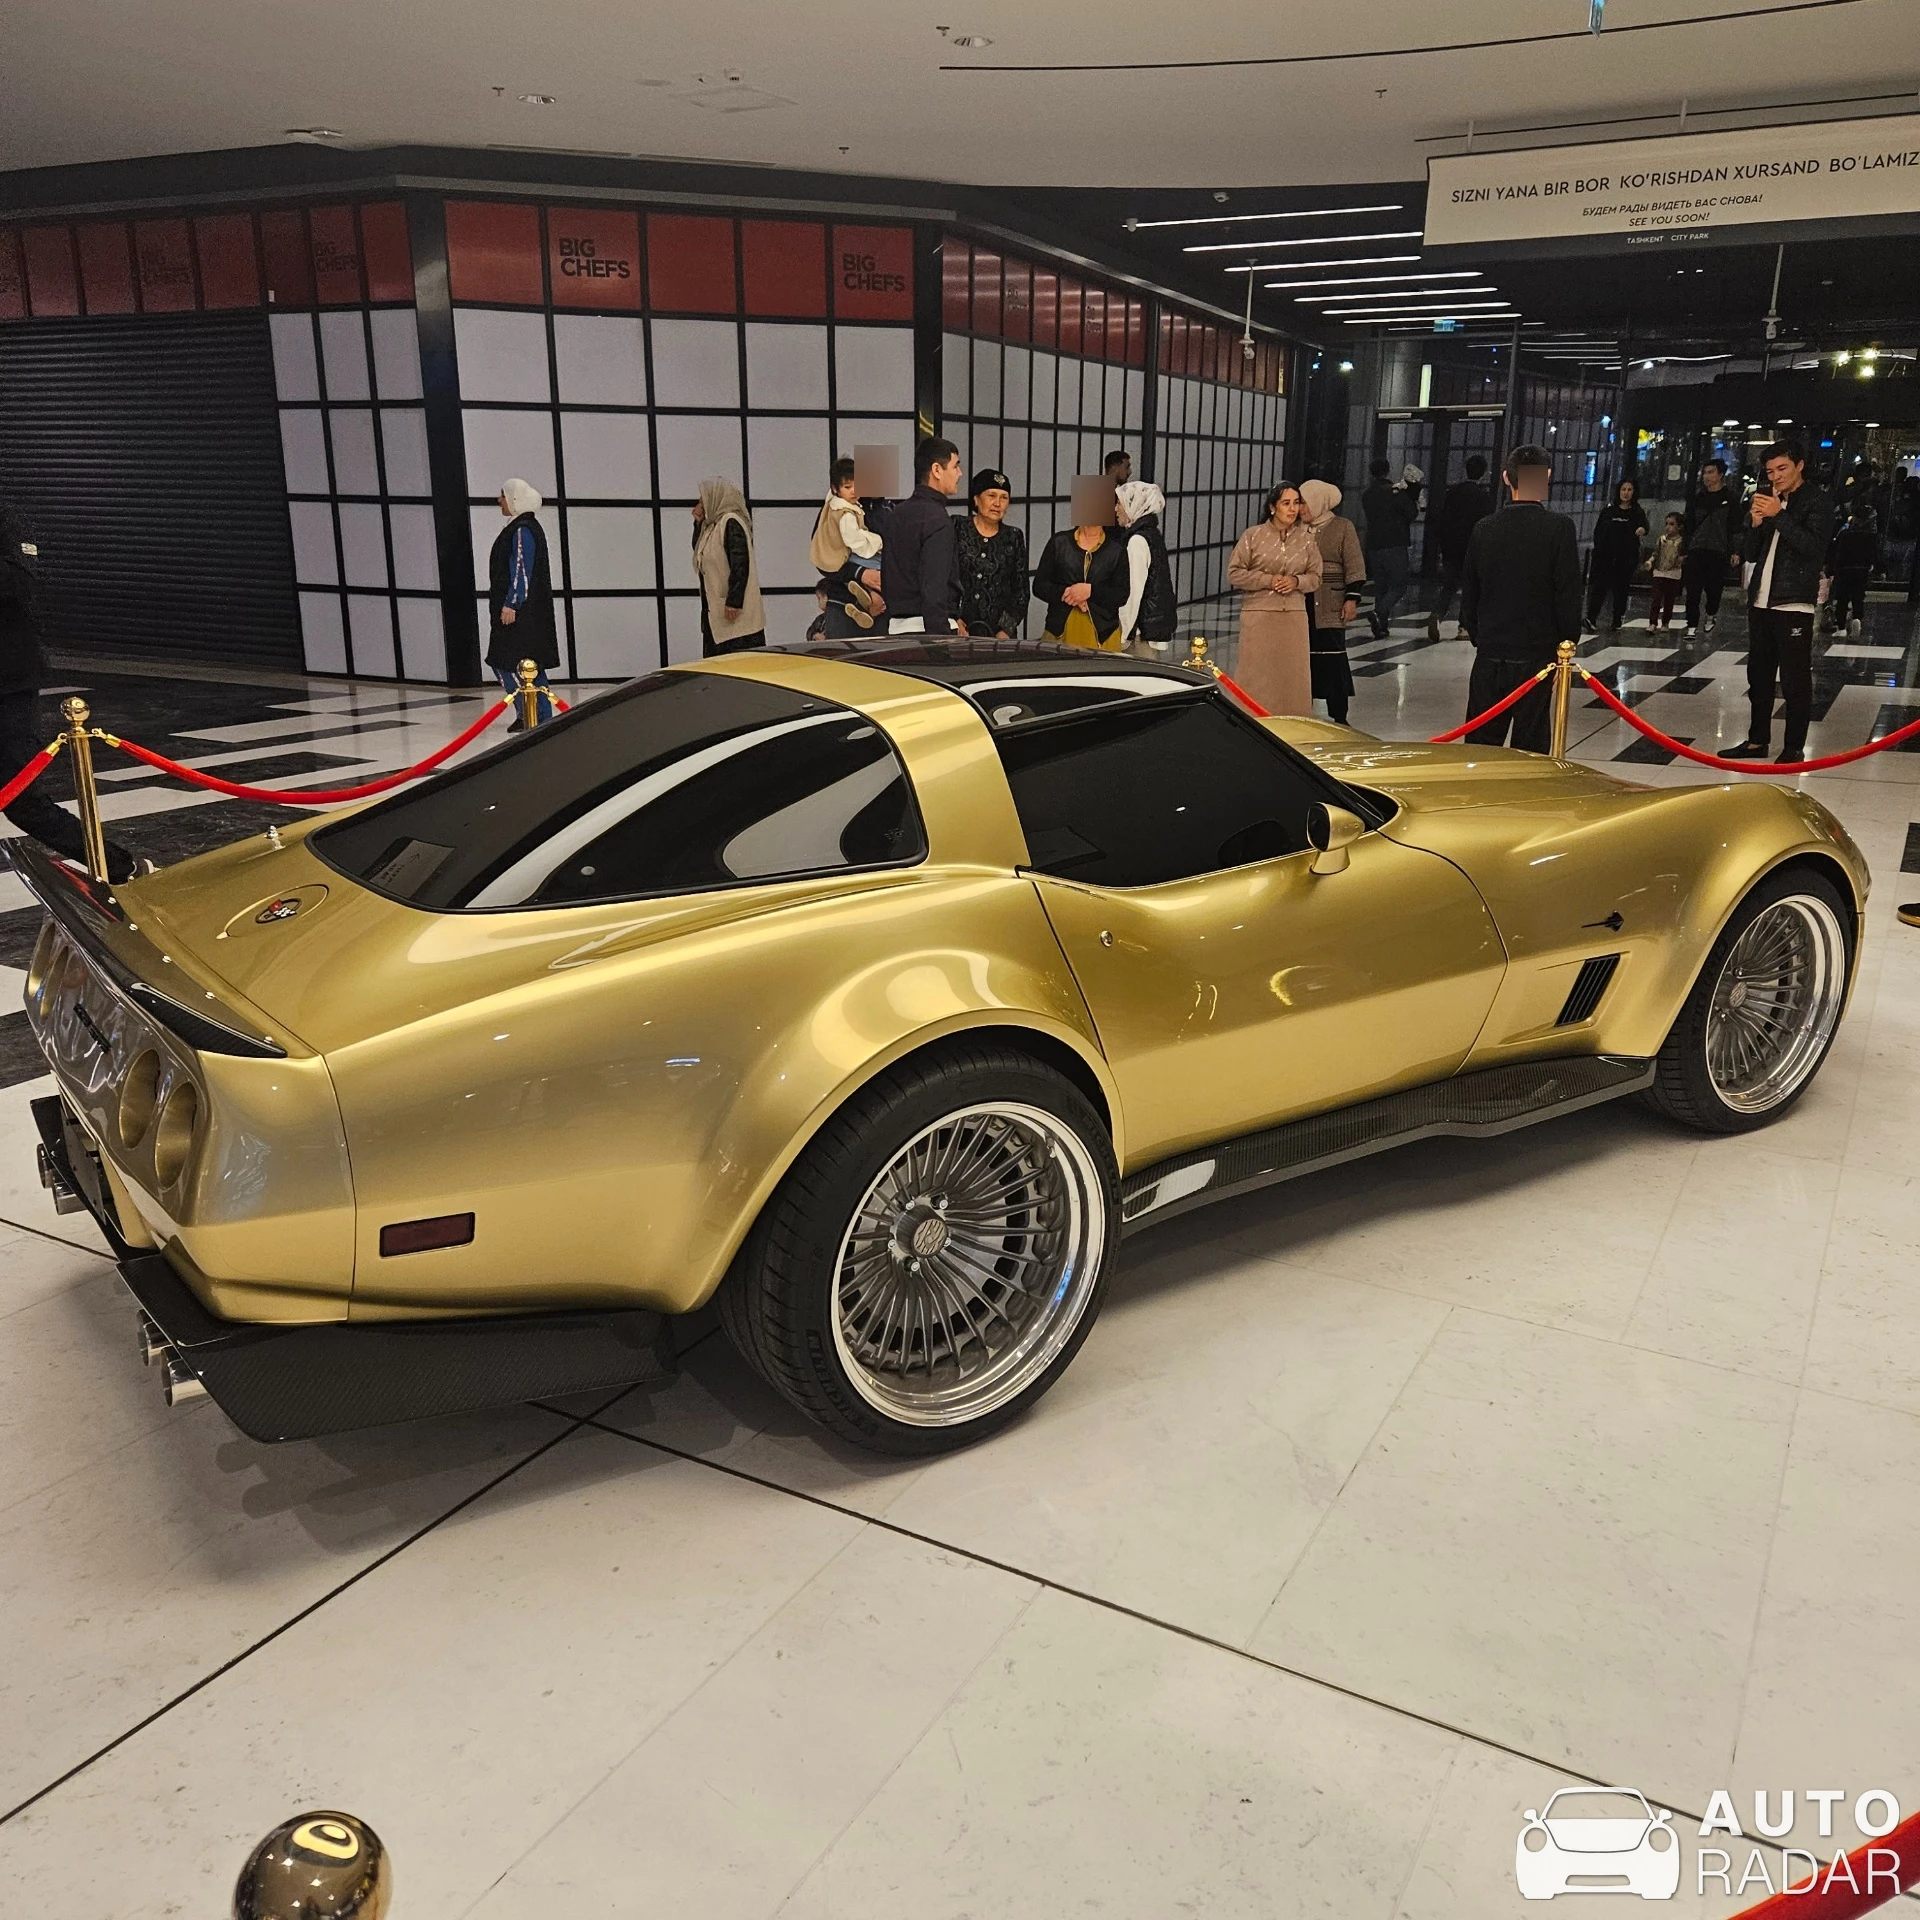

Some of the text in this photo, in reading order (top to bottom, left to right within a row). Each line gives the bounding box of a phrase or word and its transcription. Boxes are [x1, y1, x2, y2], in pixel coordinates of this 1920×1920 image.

[1451, 151, 1920, 203] SIZNI YANA BIR BOR KO'RISHDAN XURSAND BO'LAMIZ
[1583, 194, 1763, 217] БУДЕМ РАДЫ ВИДЕТЬ ВАС СНОВА!
[1629, 212, 1710, 226] SEE YOU SOON!
[1627, 235, 1664, 244] TASHKENT
[1689, 232, 1709, 240] PARK
[559, 239, 595, 257] BIG
[561, 258, 631, 278] CHEFS
[843, 253, 876, 272] BIG
[844, 272, 906, 292] CHEFS
